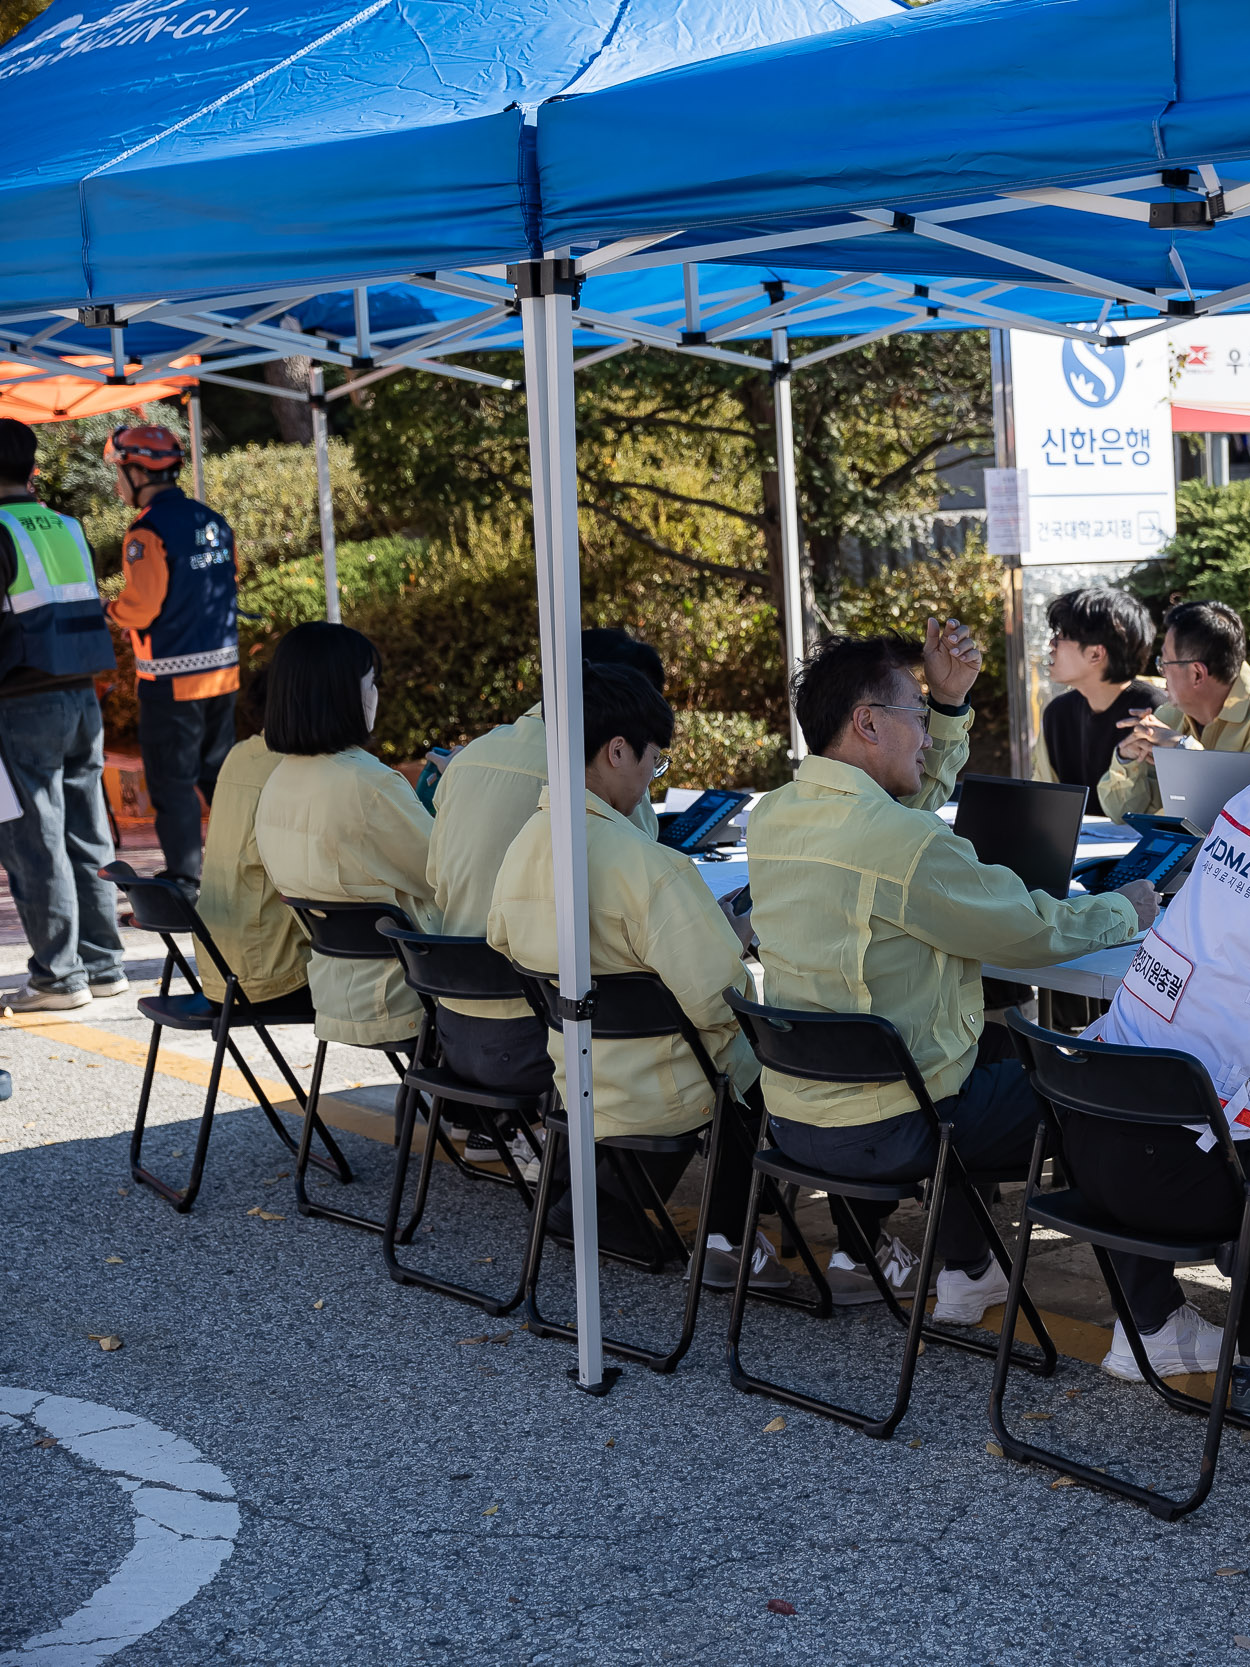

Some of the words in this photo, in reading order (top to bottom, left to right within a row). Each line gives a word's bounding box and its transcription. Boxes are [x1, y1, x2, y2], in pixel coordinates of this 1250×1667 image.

[1041, 427, 1151, 466] 신한은행
[1038, 519, 1132, 541] 건국대학교지점
[1132, 945, 1184, 1001] 행정지원총괄
